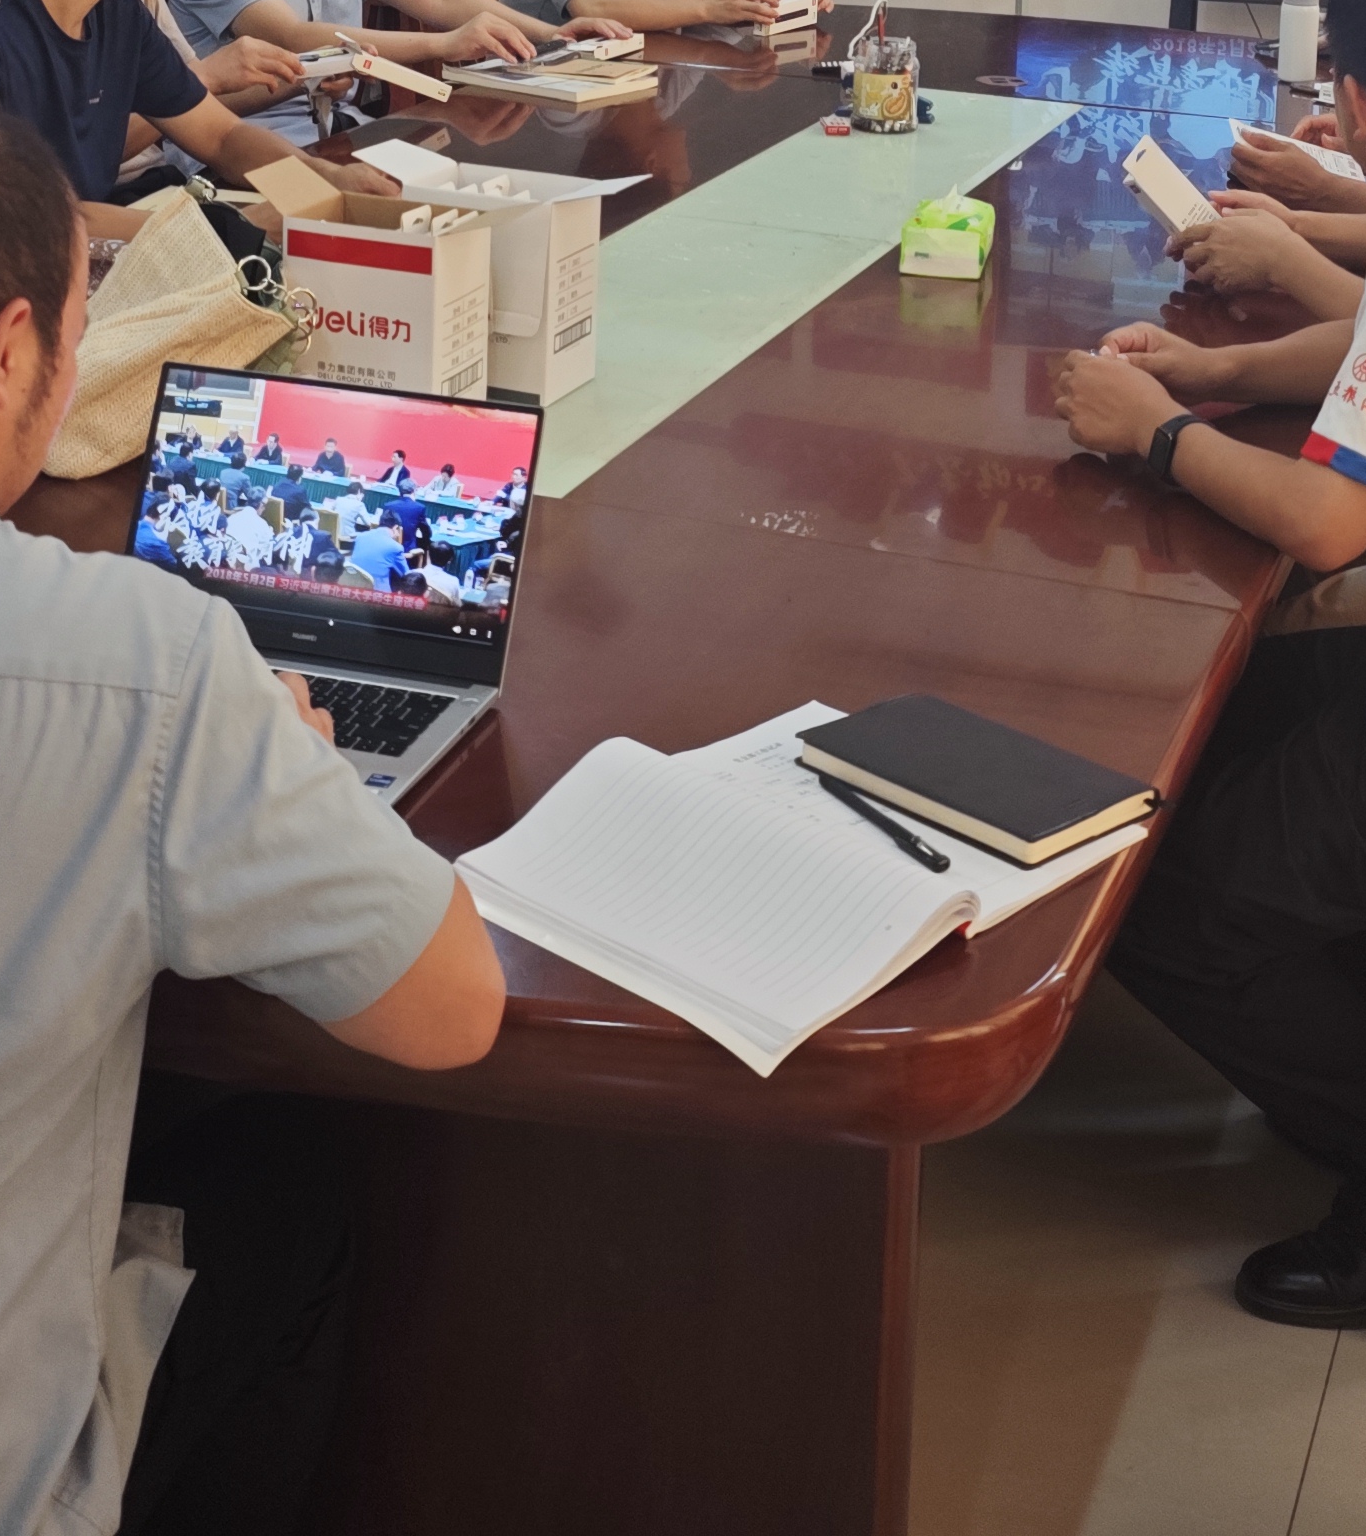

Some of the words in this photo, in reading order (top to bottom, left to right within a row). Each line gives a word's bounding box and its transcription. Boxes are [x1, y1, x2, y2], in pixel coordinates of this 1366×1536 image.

[369, 316, 411, 343] 得力
[317, 360, 396, 381] 得力集团有限公司
[206, 567, 276, 589] 2018年5月2日
